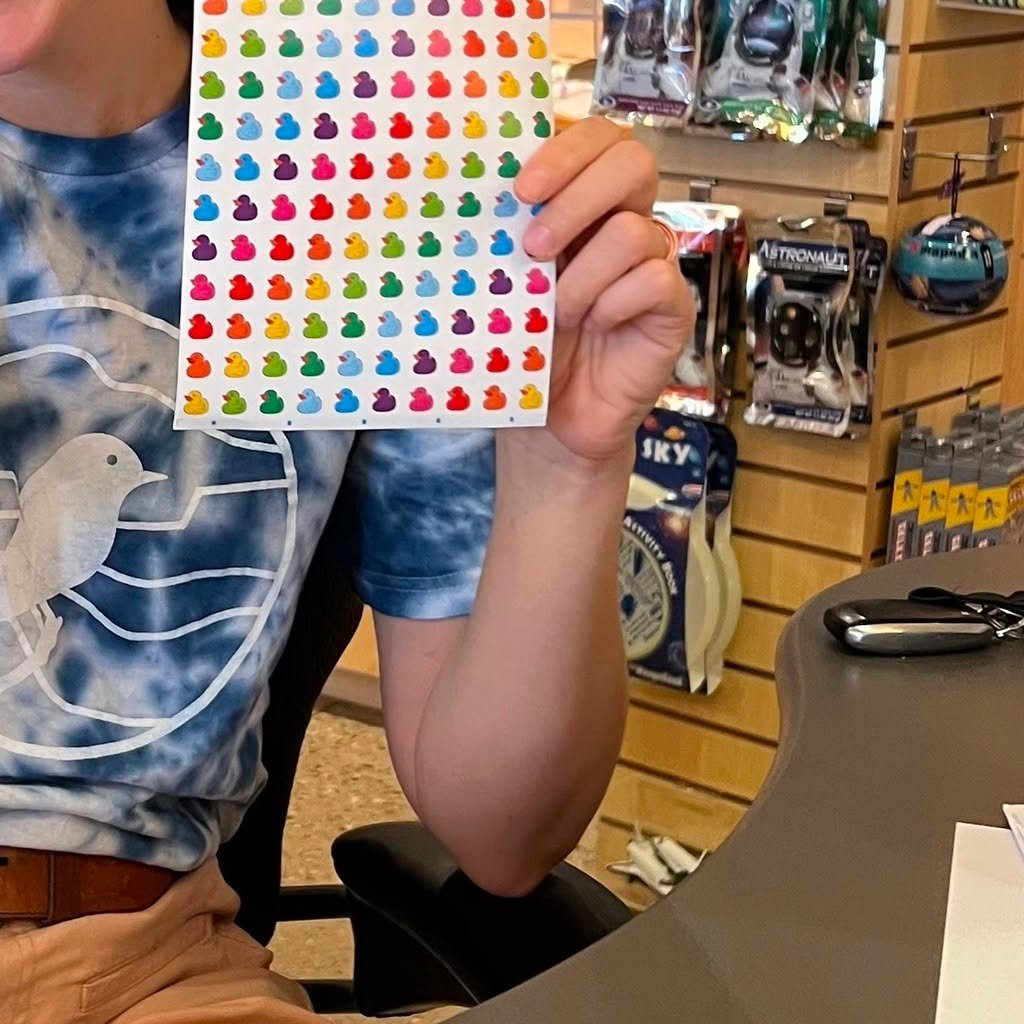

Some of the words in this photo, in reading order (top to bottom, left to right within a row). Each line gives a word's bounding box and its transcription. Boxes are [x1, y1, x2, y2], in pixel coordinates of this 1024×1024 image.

[758, 239, 847, 268] ASTRONAUT
[641, 437, 691, 466] SKY
[624, 515, 666, 561] ACTIVITY
